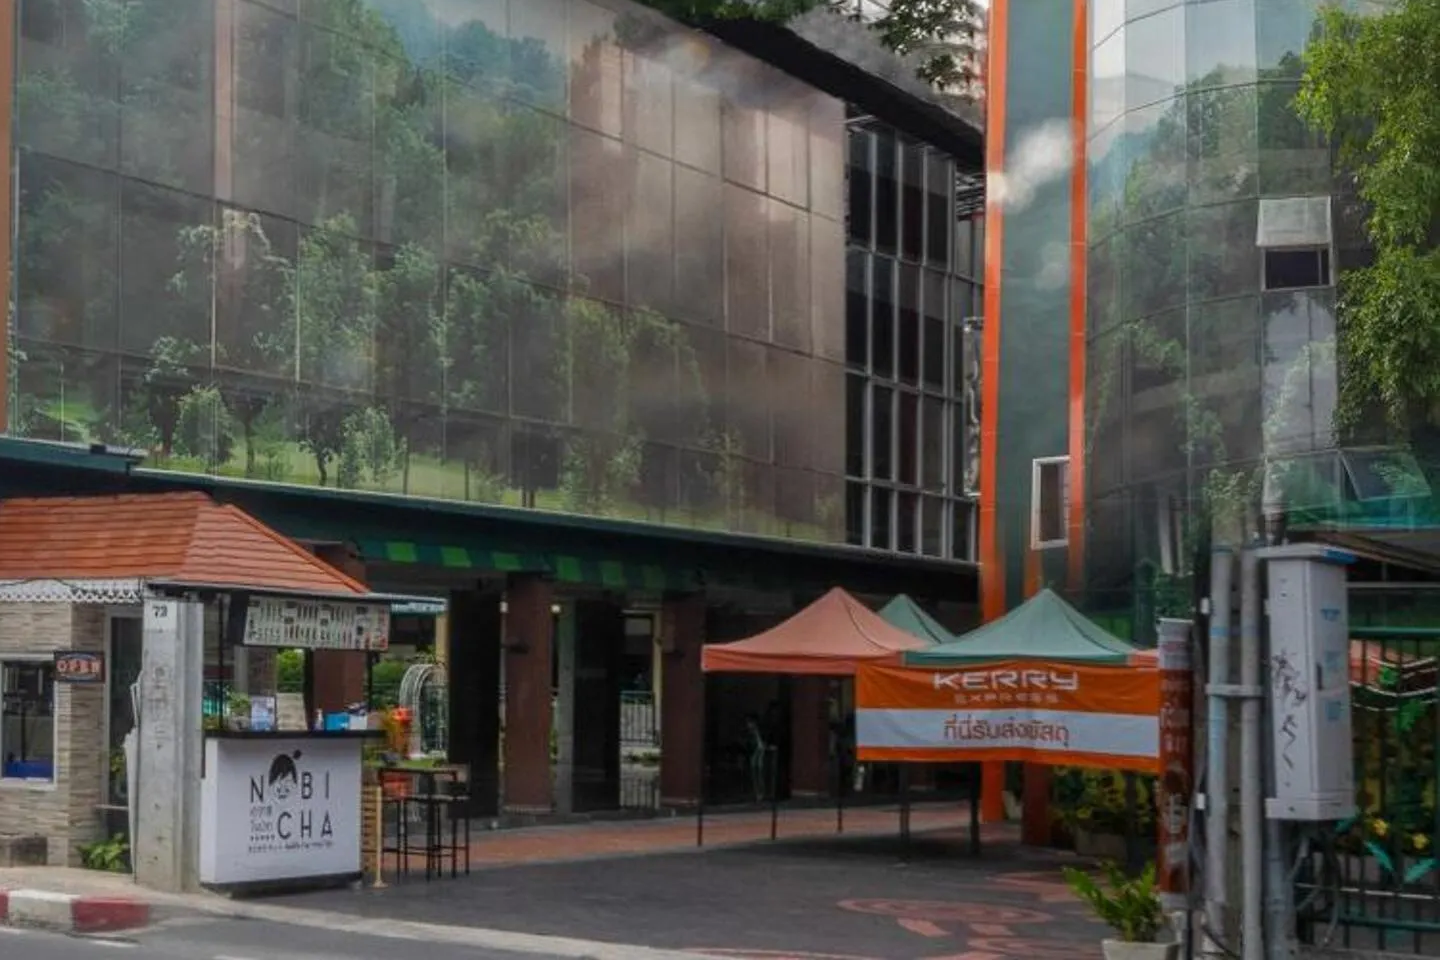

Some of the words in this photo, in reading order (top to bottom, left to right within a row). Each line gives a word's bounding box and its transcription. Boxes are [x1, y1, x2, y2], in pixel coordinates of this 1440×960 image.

[56, 660, 101, 673] OPEN
[934, 670, 1078, 690] KERRY
[955, 692, 1059, 704] EXPRESS
[277, 810, 333, 839] CHA
